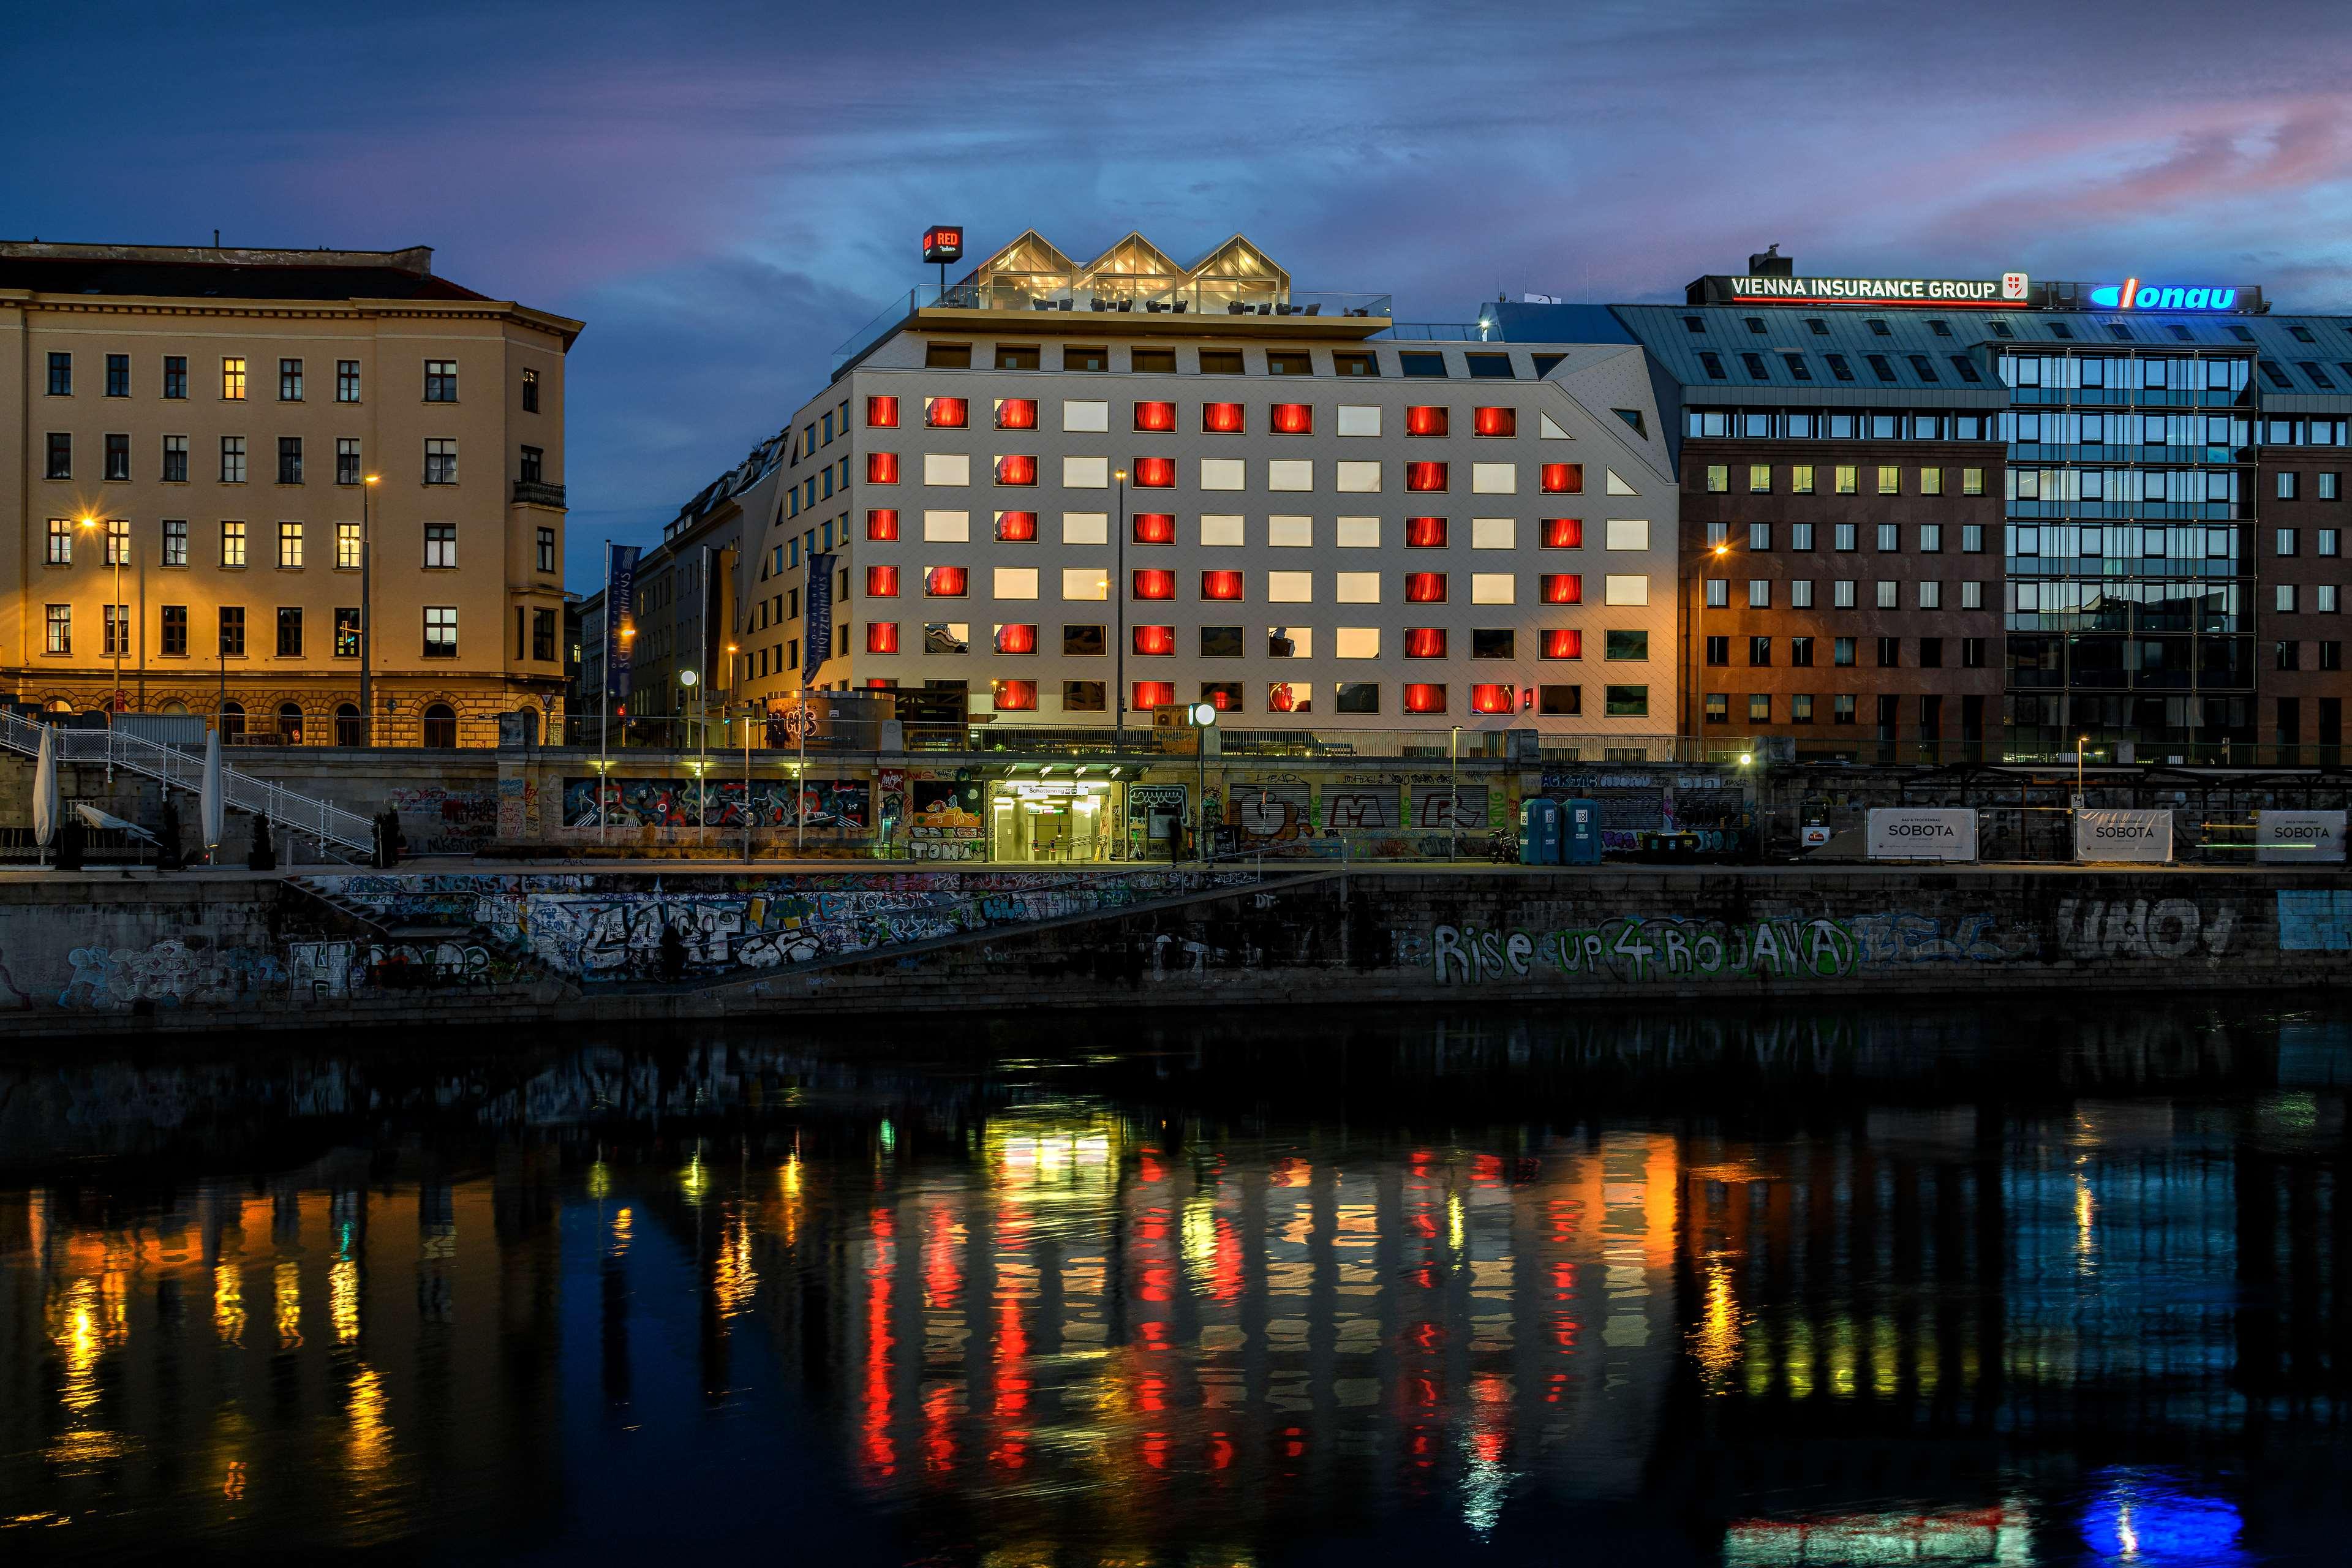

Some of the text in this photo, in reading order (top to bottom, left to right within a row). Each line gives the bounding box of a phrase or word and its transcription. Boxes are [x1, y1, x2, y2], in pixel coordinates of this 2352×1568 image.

[938, 233, 958, 245] RED
[1732, 278, 1996, 298] VIENNA INSURANCE GROUP
[1489, 792, 1506, 827] KING
[1888, 825, 1954, 836] SOBOTA
[2096, 827, 2154, 838] SOBOTA
[2275, 827, 2329, 838] SOBOTA
[1613, 922, 1654, 982] 4
